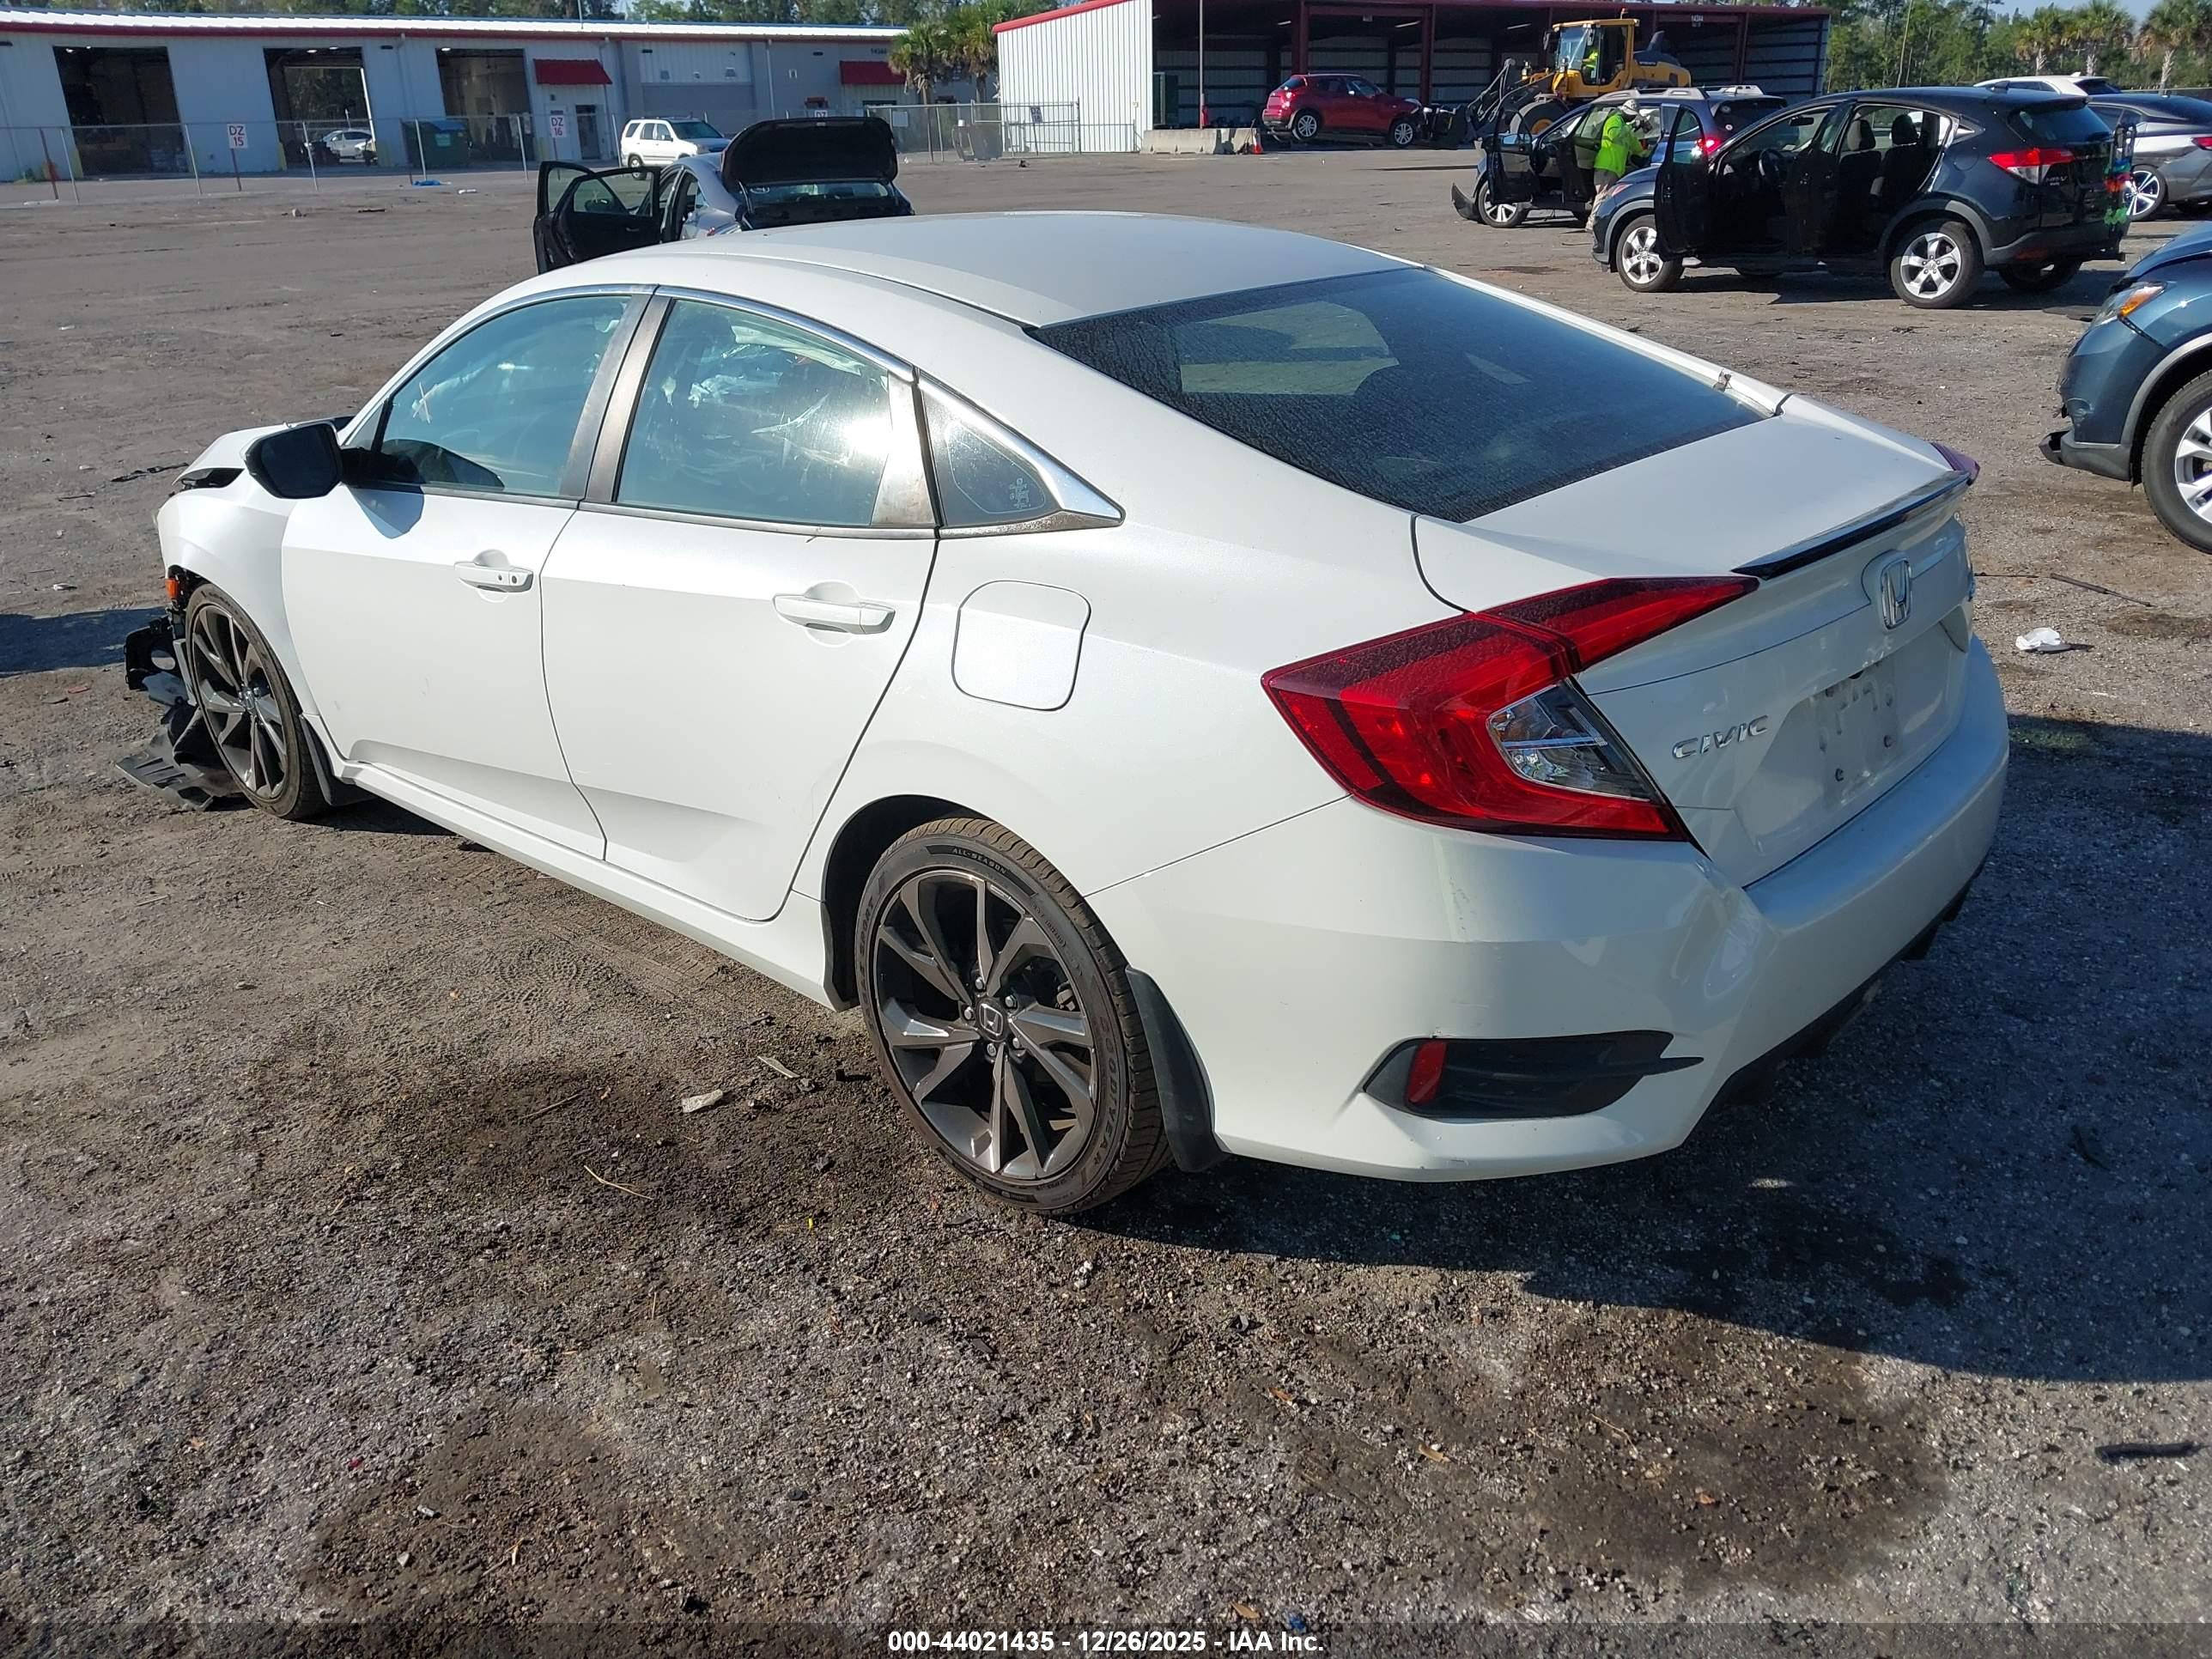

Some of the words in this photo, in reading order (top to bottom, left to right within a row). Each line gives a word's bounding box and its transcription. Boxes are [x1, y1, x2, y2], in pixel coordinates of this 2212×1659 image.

[229, 125, 245, 136] DZ
[551, 117, 563, 126] DZ
[555, 127, 562, 137] 16
[234, 137, 244, 146] 15
[1672, 714, 1768, 759] CIVIC
[952, 848, 1006, 874] ALL-SEASON
[860, 896, 874, 955] SPORT
[1092, 1017, 1116, 1165] GOODYEAR
